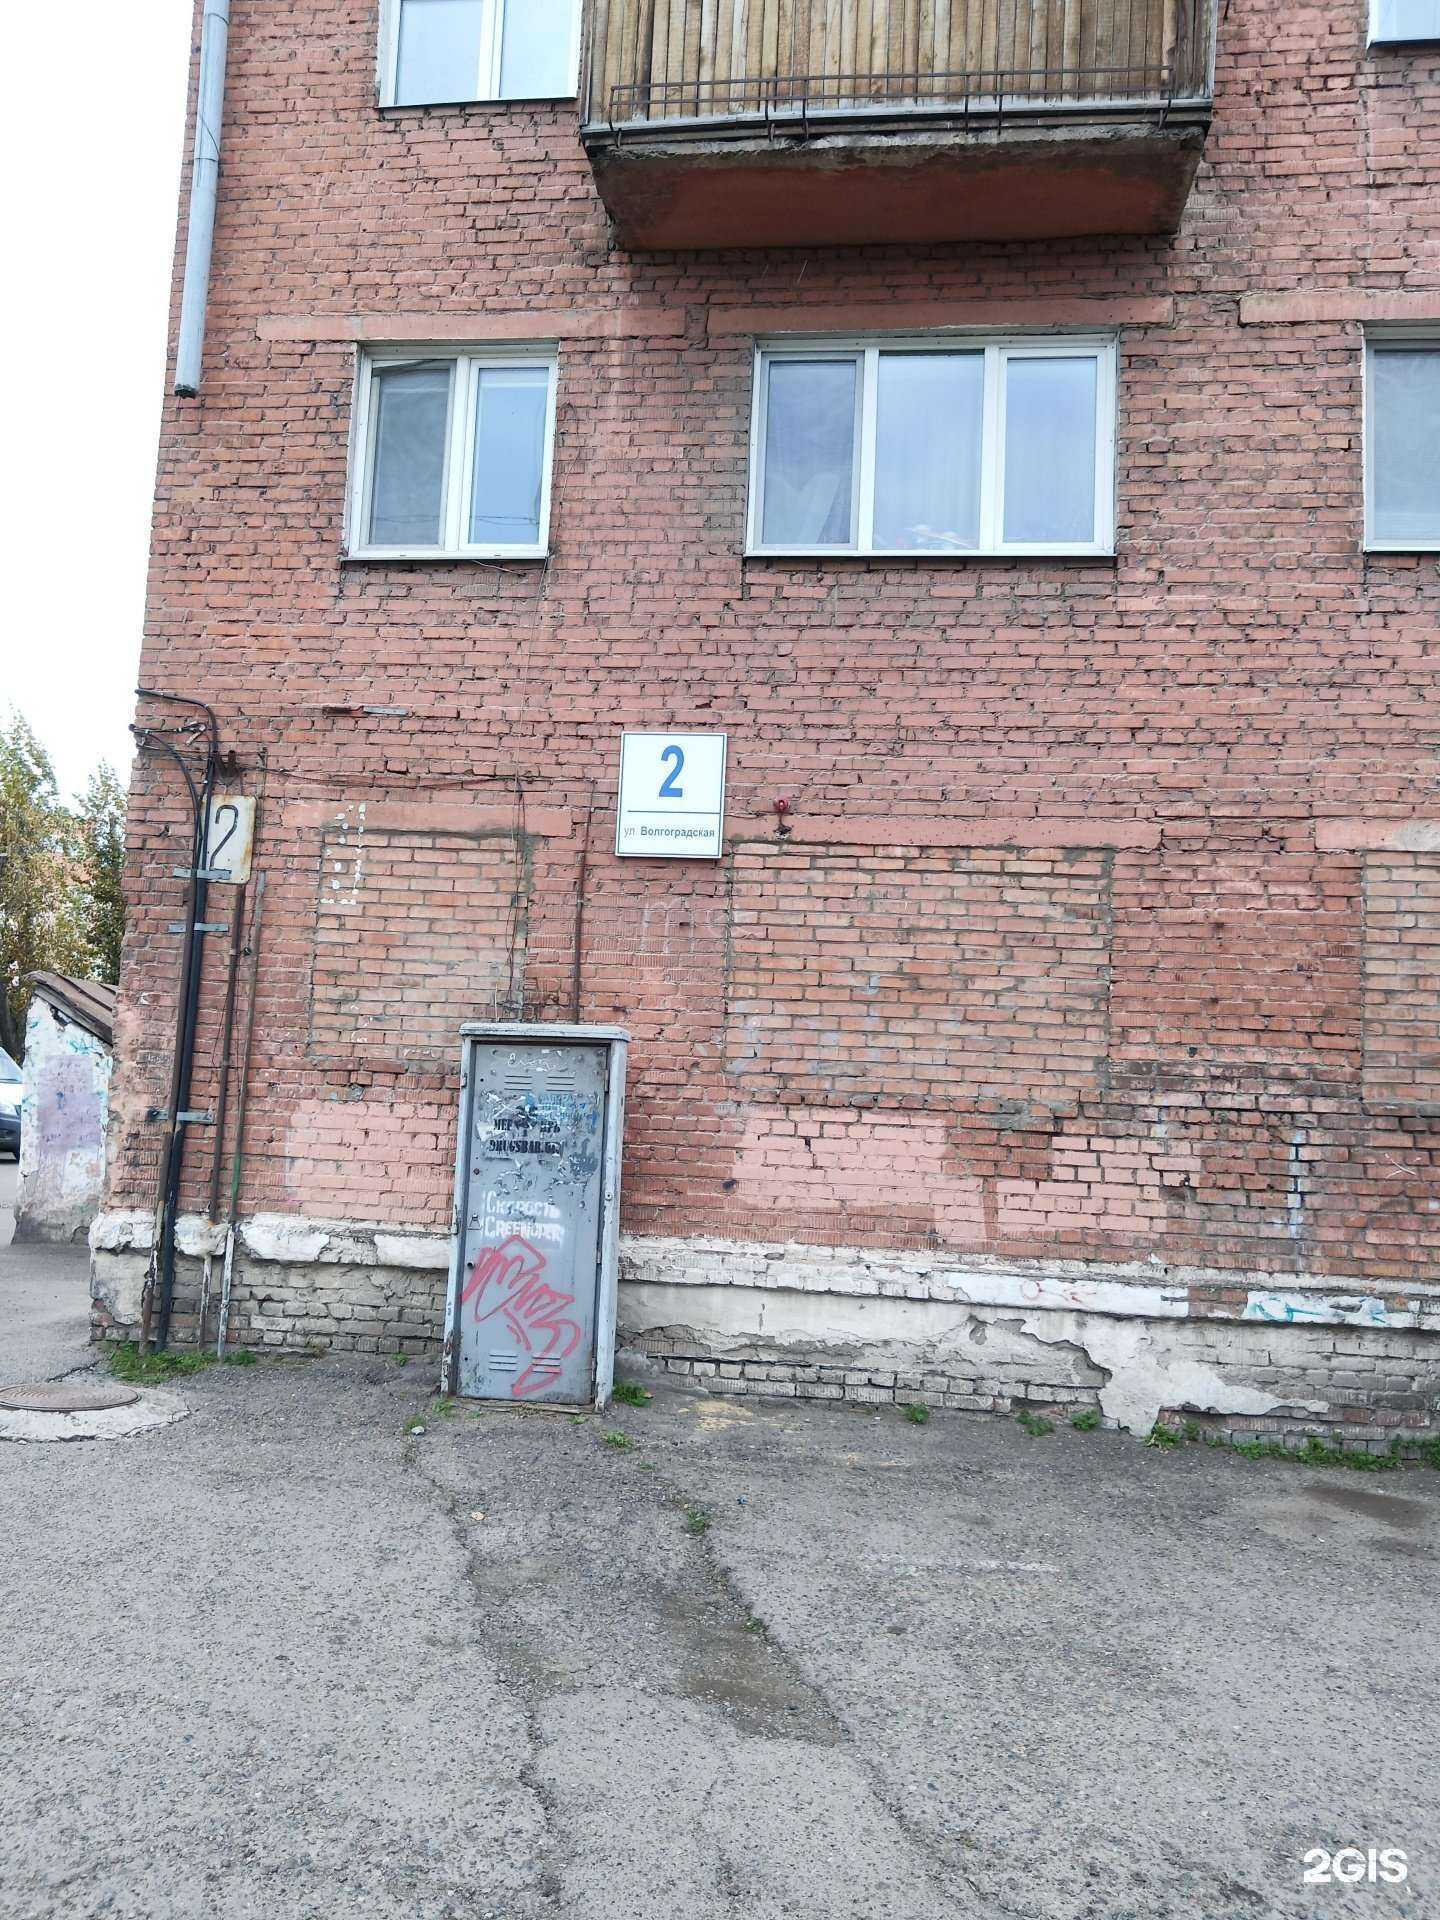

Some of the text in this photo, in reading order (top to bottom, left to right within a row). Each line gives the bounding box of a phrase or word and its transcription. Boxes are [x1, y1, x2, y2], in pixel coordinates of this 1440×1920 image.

[658, 744, 685, 798] 2
[208, 804, 239, 872] 2
[640, 826, 715, 839] Волгоградская
